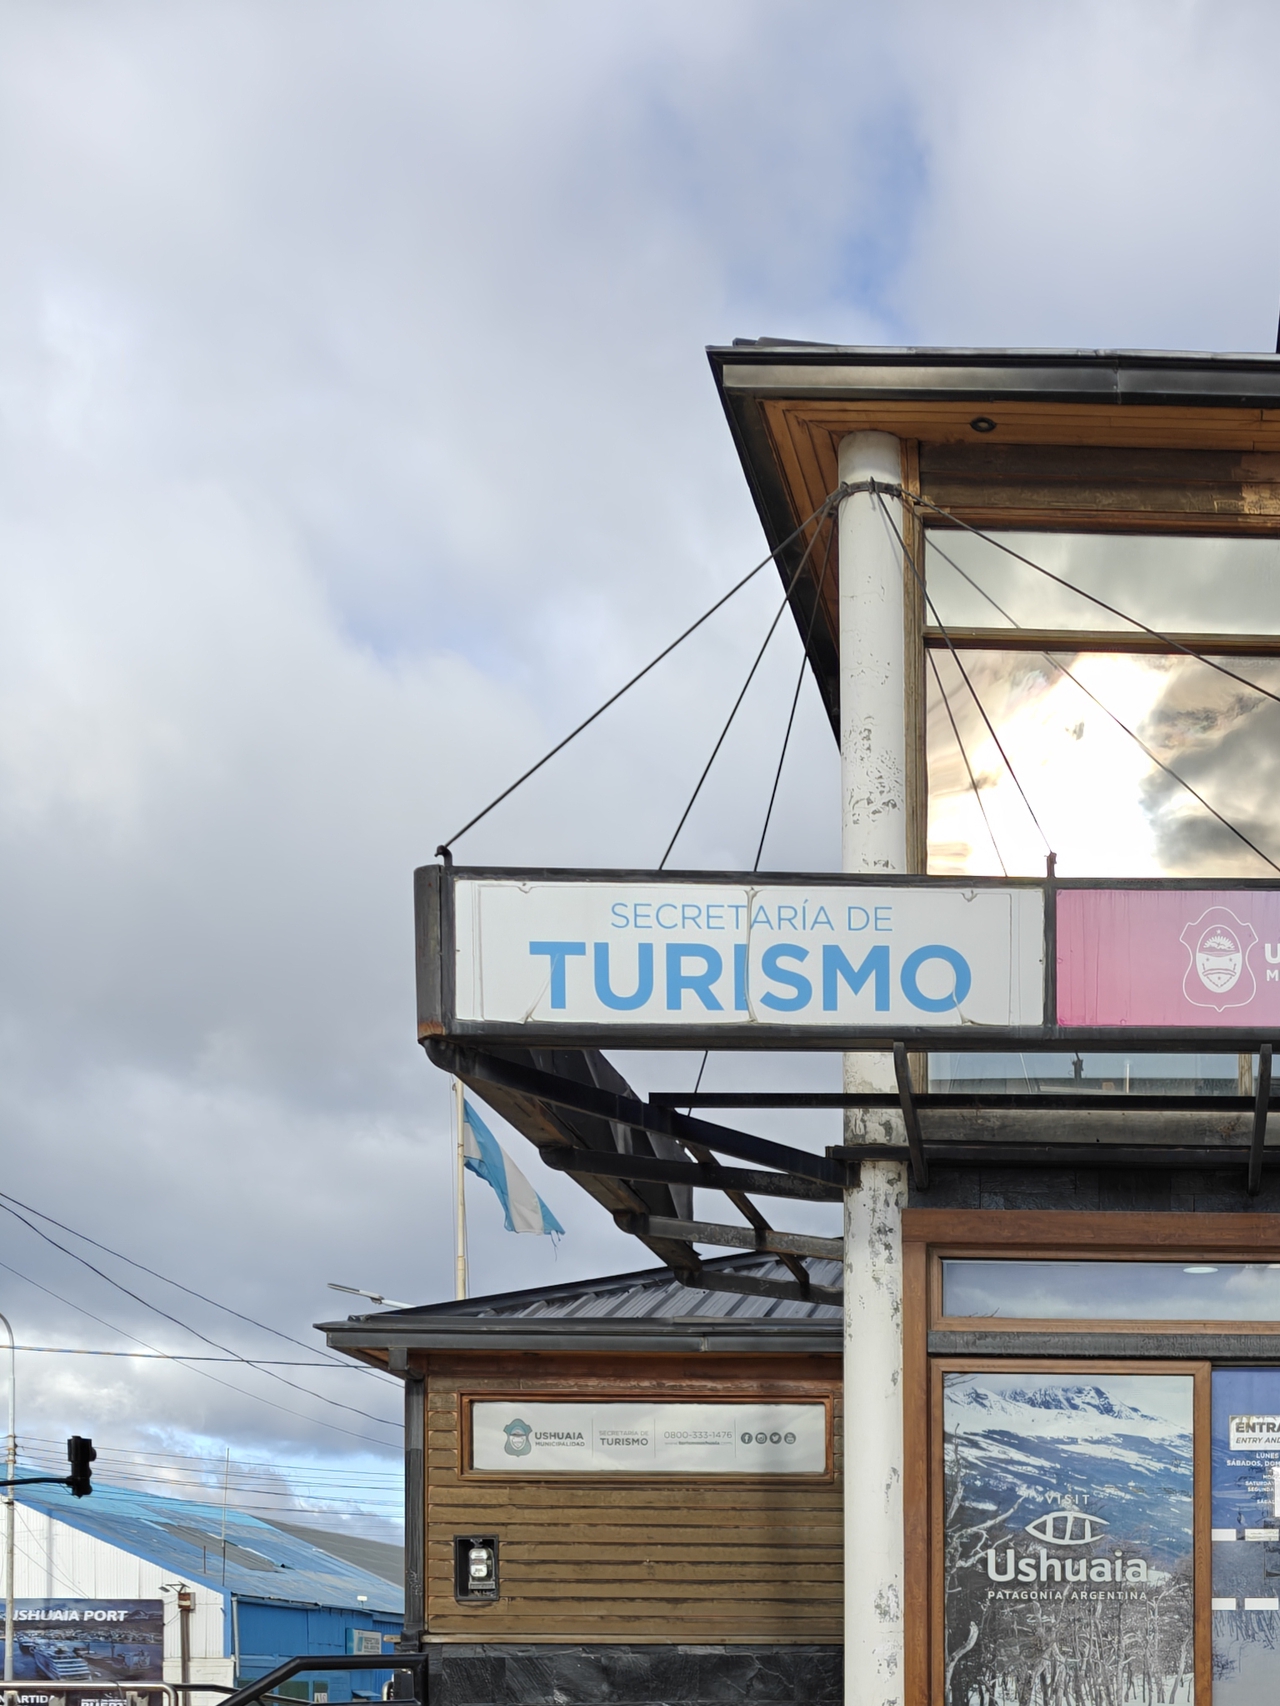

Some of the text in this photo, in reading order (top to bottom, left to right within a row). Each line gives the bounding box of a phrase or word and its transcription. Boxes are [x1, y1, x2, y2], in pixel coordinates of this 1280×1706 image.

[610, 899, 894, 932] SECRETARÍA DE
[529, 940, 972, 1014] TURISMO
[534, 1431, 584, 1440] USHUAIA
[663, 1430, 733, 1440] 0800-333-1476
[1235, 1436, 1264, 1444] ENTRY
[599, 1437, 649, 1446] TURISMO
[1256, 1452, 1279, 1460] LUNES
[1226, 1458, 1264, 1467] SÁBADOS,
[1045, 1494, 1090, 1505] VISIT
[987, 1548, 1148, 1583] Ushuaia
[987, 1590, 1148, 1600] PATAGONIA ARGENTINA
[83, 1609, 129, 1622] PORT
